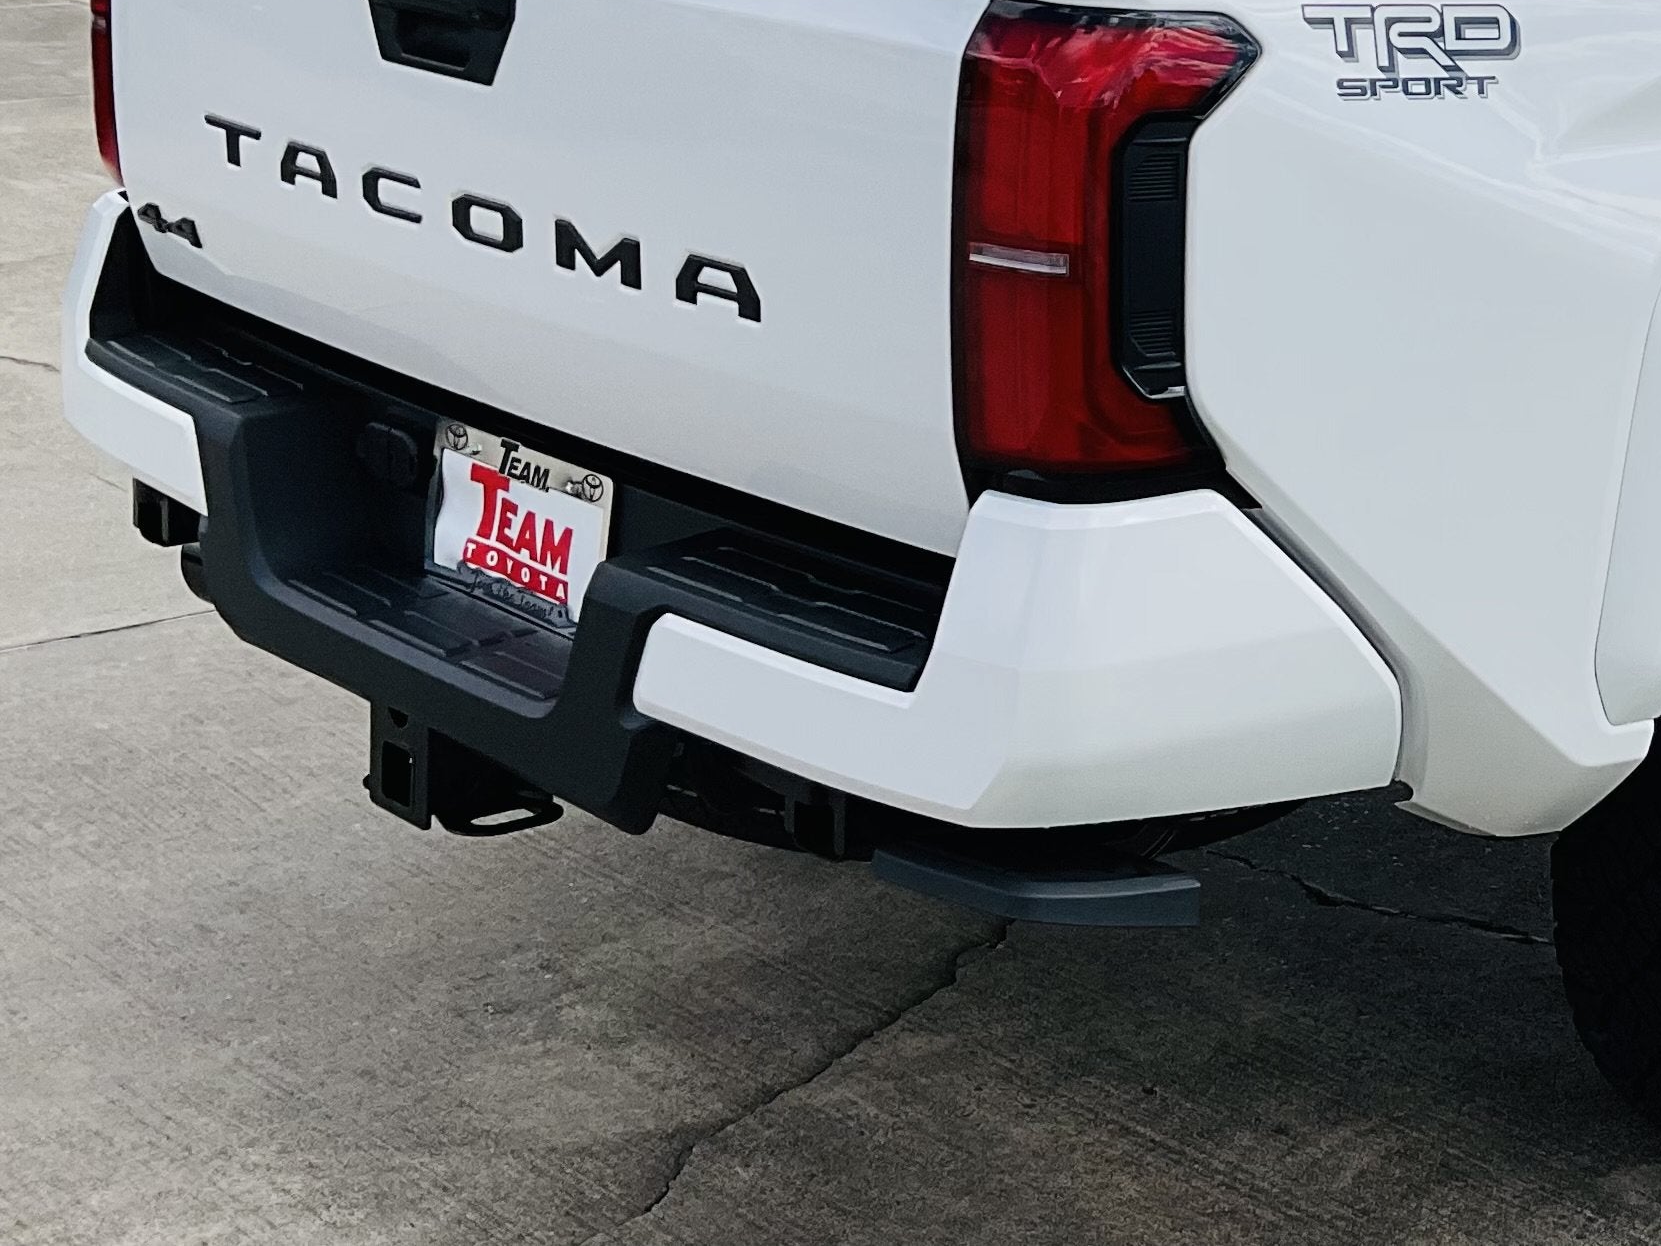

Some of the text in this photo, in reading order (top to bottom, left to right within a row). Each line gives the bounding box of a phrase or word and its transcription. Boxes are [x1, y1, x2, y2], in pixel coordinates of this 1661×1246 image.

[1301, 3, 1522, 78] TRD
[1336, 76, 1499, 101] SPORT
[203, 113, 762, 323] TACOMA
[470, 461, 574, 576] TEAM
[466, 542, 566, 600] TOYOTA
